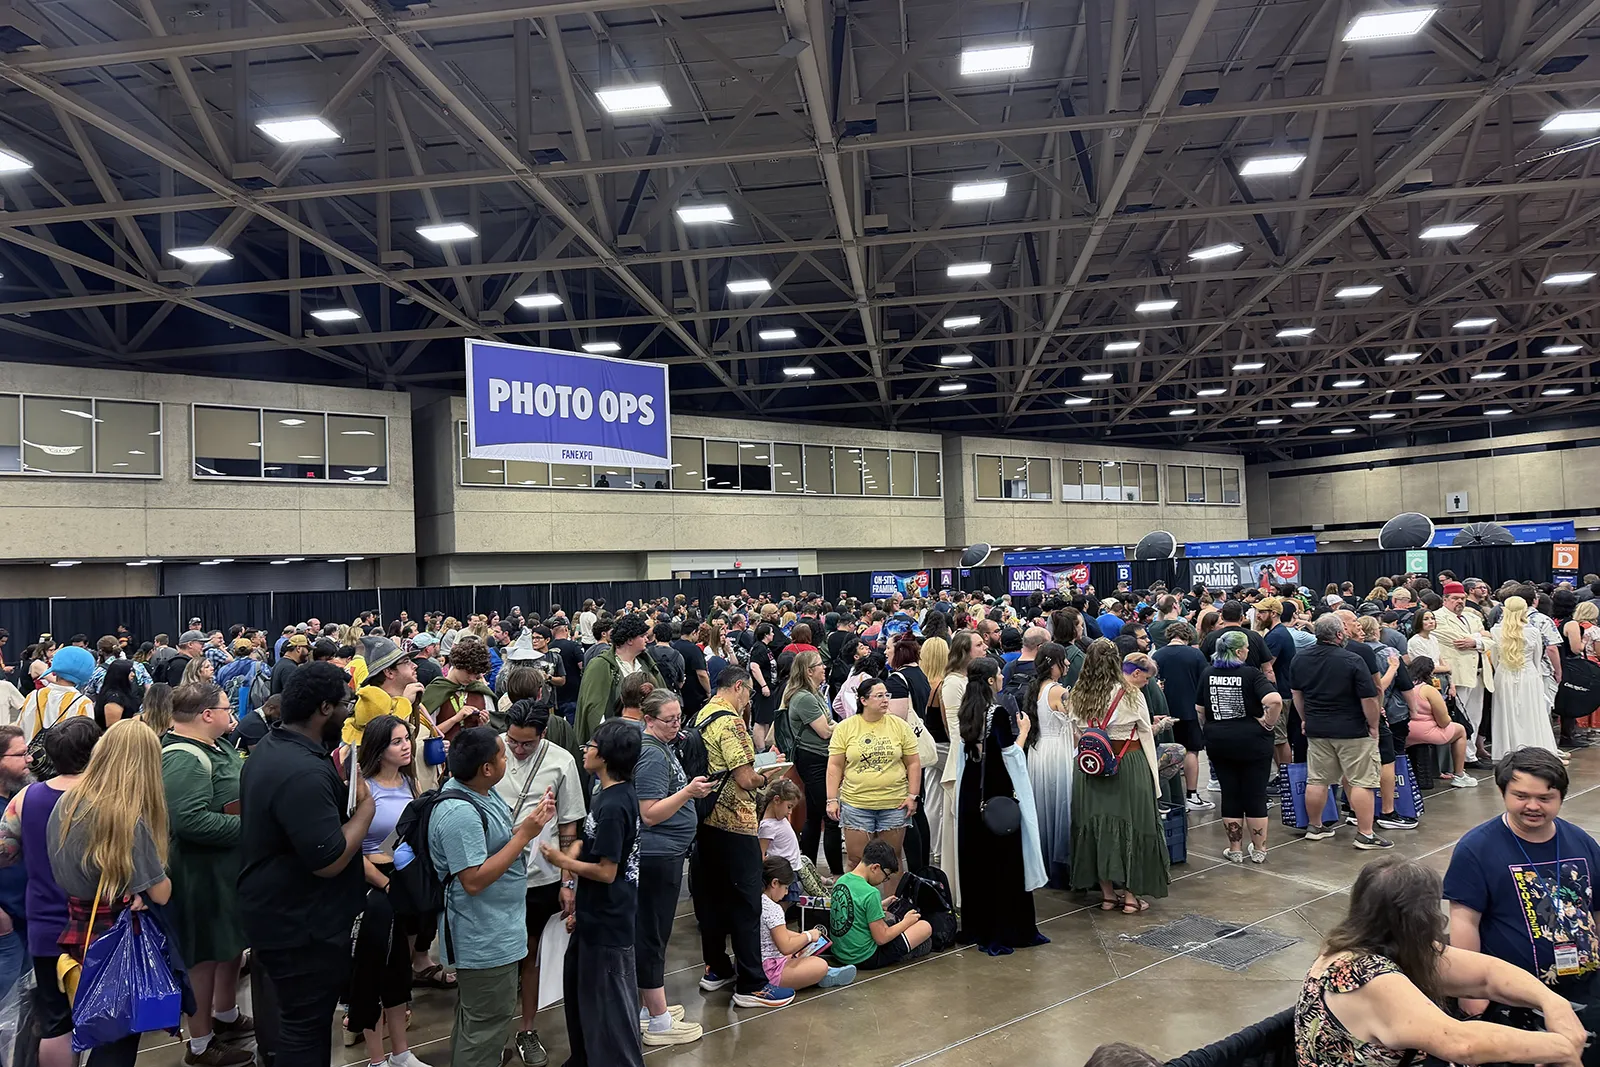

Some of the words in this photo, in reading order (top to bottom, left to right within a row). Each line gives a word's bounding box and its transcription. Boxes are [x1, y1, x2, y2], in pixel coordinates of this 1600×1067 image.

[488, 378, 593, 420] PHOTO
[599, 389, 655, 426] OPS
[561, 449, 593, 461] FANEXPO
[1410, 556, 1423, 571] C
[1557, 551, 1573, 567] D
[1195, 562, 1234, 575] ON-SITE
[1276, 559, 1296, 573] $25
[942, 574, 950, 585] A
[1013, 570, 1042, 581] ON-SITE
[1072, 567, 1087, 580] $25
[1120, 568, 1129, 580] B
[873, 575, 895, 585] ON-SITE
[1011, 580, 1045, 591] FRAMING
[1192, 574, 1239, 587] FRAMING
[872, 584, 898, 594] FRAMING
[1209, 675, 1242, 687] FANEXPO
